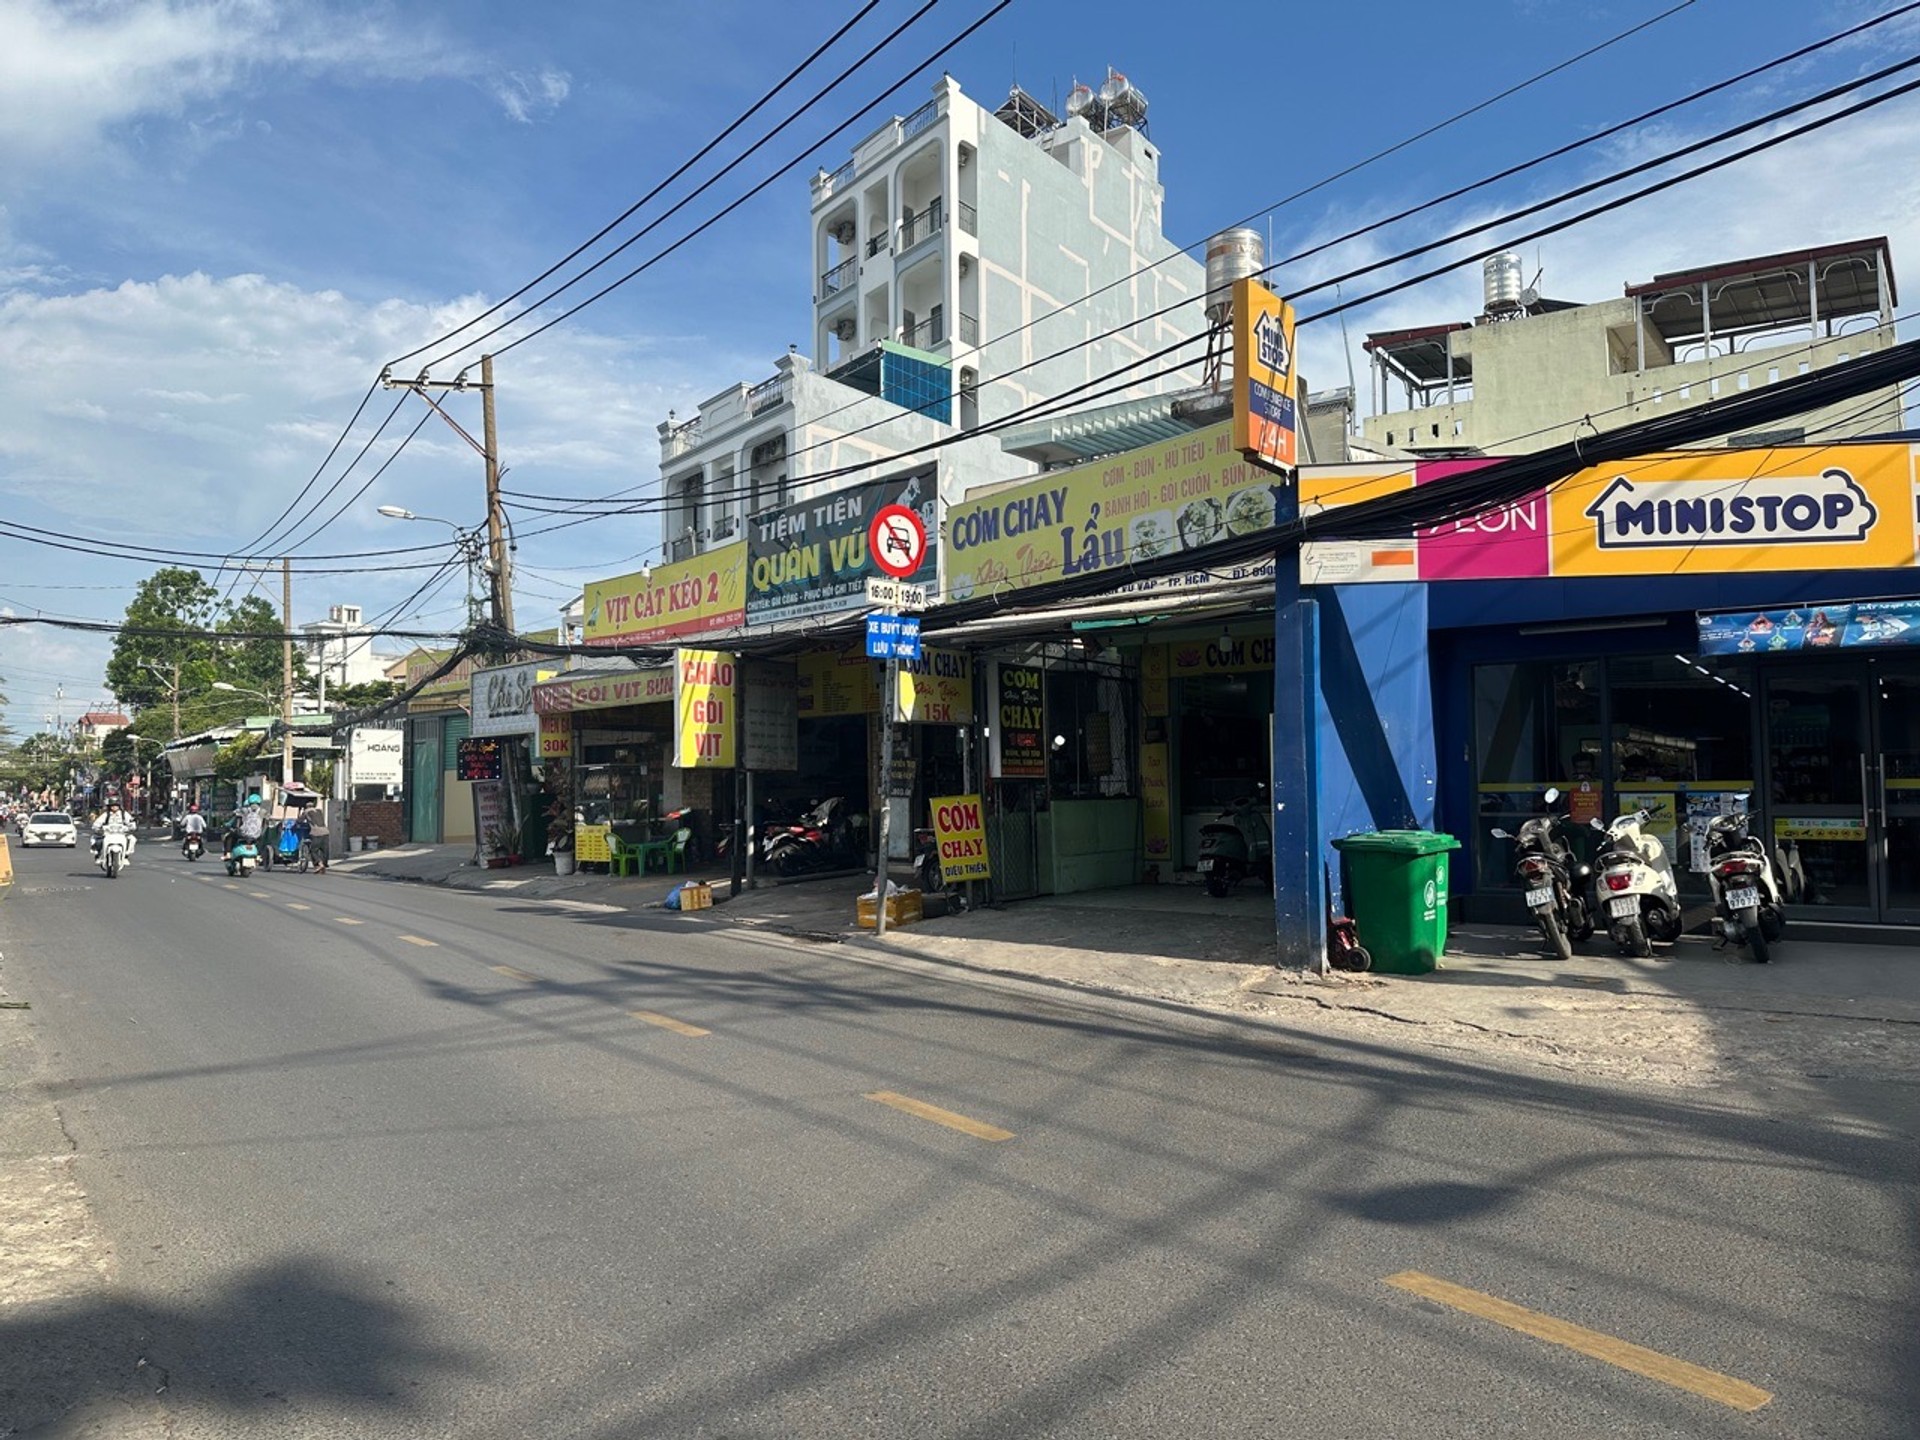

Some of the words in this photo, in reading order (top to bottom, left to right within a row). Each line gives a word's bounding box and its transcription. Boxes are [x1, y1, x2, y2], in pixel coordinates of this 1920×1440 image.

[1262, 324, 1283, 348] MINI
[1261, 342, 1285, 368] STOP
[1264, 402, 1282, 419] STORE
[759, 512, 806, 542] TIỆM
[813, 495, 863, 526] TIỆN
[952, 505, 1000, 551] CƠM
[1003, 486, 1069, 538] CHAY
[1615, 493, 1854, 537] MINISTOP
[1060, 502, 1126, 576] Lẩu
[752, 541, 820, 592] QUÂN
[828, 526, 868, 572] VŨ
[1185, 574, 1210, 585] HCM
[605, 594, 631, 630] VỊT
[634, 576, 666, 619] CẮT
[668, 572, 703, 613] KÉO
[706, 570, 719, 604] 2
[870, 585, 894, 600] 16:00
[901, 589, 923, 605] 19:00
[868, 621, 880, 634] XE
[683, 658, 732, 687] CHÁO
[935, 651, 967, 679] CHAY
[613, 680, 642, 703] VỊT
[1002, 668, 1039, 690] CƠM
[693, 692, 723, 724] GỎI
[924, 702, 951, 721] 15K
[1000, 705, 1042, 729] CHAY
[543, 739, 569, 752] 30K
[695, 732, 722, 761] VỊT
[938, 801, 981, 833] CƠM
[941, 838, 984, 860] CHAY
